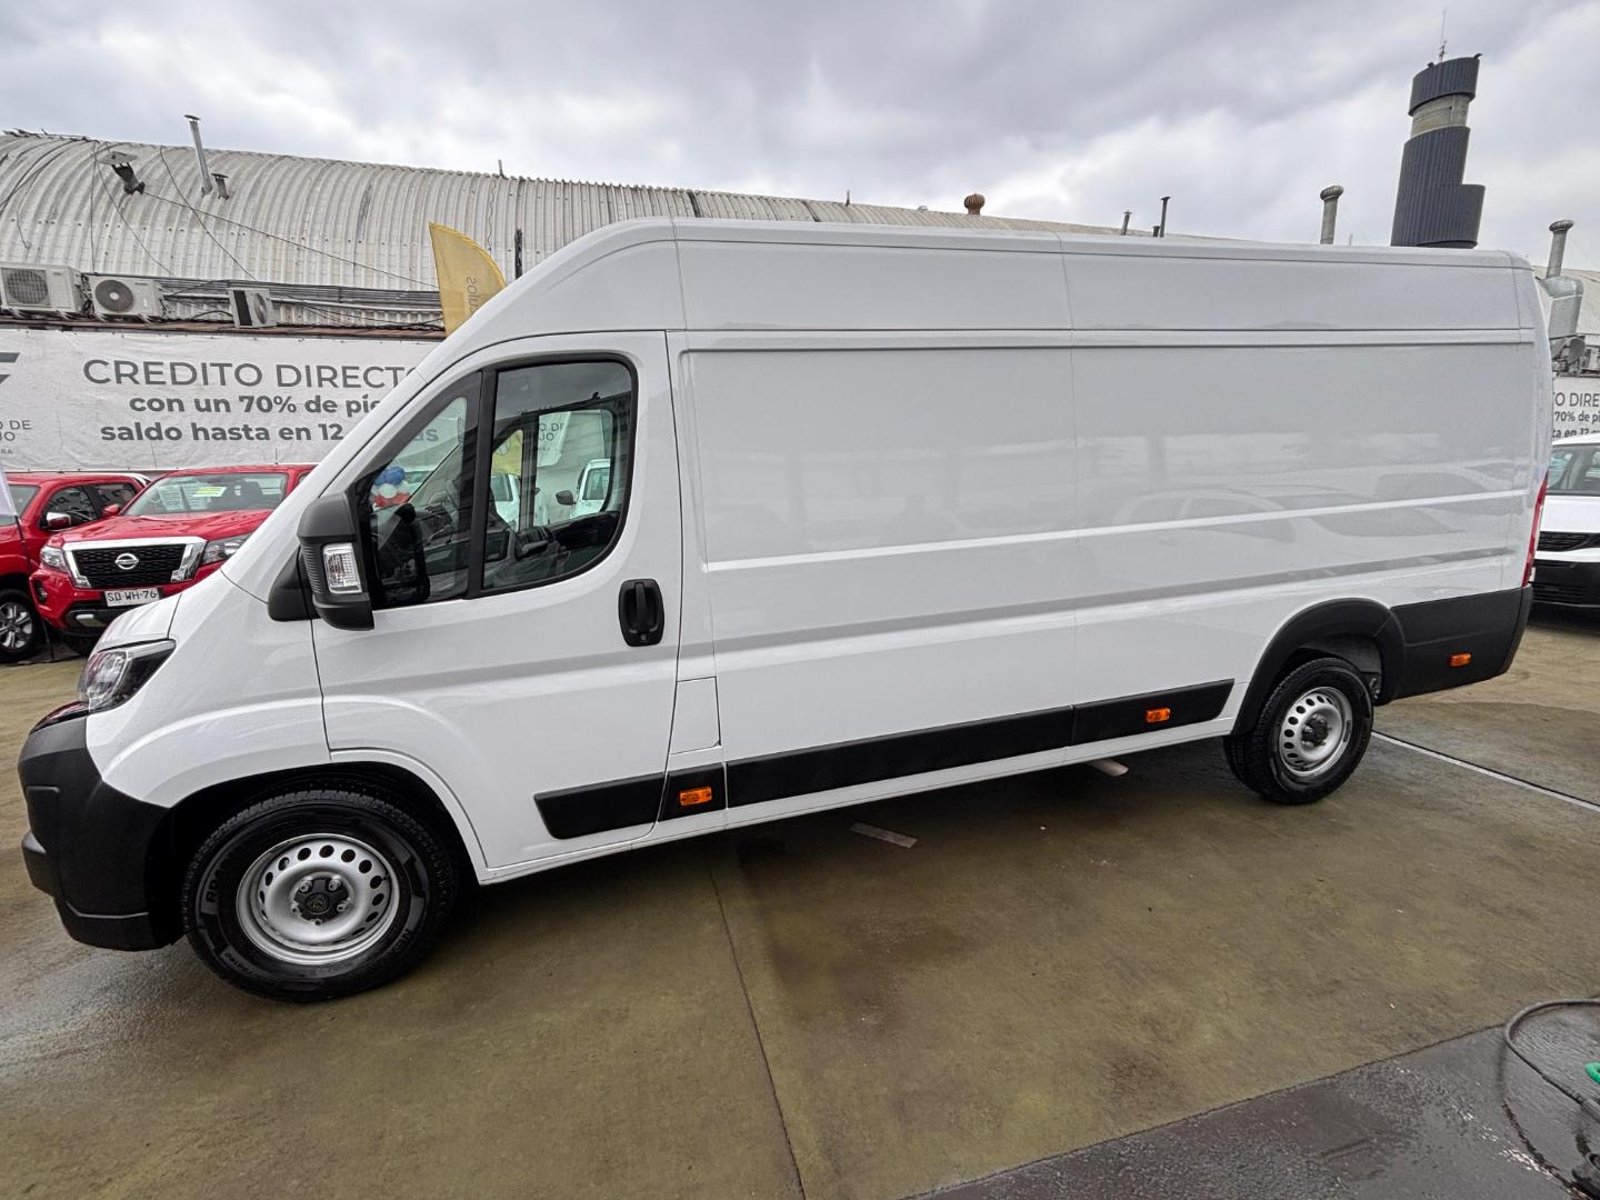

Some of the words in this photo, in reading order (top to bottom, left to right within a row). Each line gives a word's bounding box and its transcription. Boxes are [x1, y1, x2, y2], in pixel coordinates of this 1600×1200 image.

[83, 359, 262, 387] CREDITO
[276, 364, 416, 388] DIRECT
[129, 397, 185, 412] con
[194, 398, 231, 412] un
[238, 395, 297, 413] 70%
[304, 395, 338, 413] de
[1552, 392, 1566, 406] O
[1554, 411, 1576, 422] 70%
[1578, 410, 1590, 422] de
[9, 420, 32, 430] DE
[100, 422, 183, 441] saldo
[191, 423, 270, 441] hasta
[278, 426, 312, 441] en
[318, 423, 344, 441] 12
